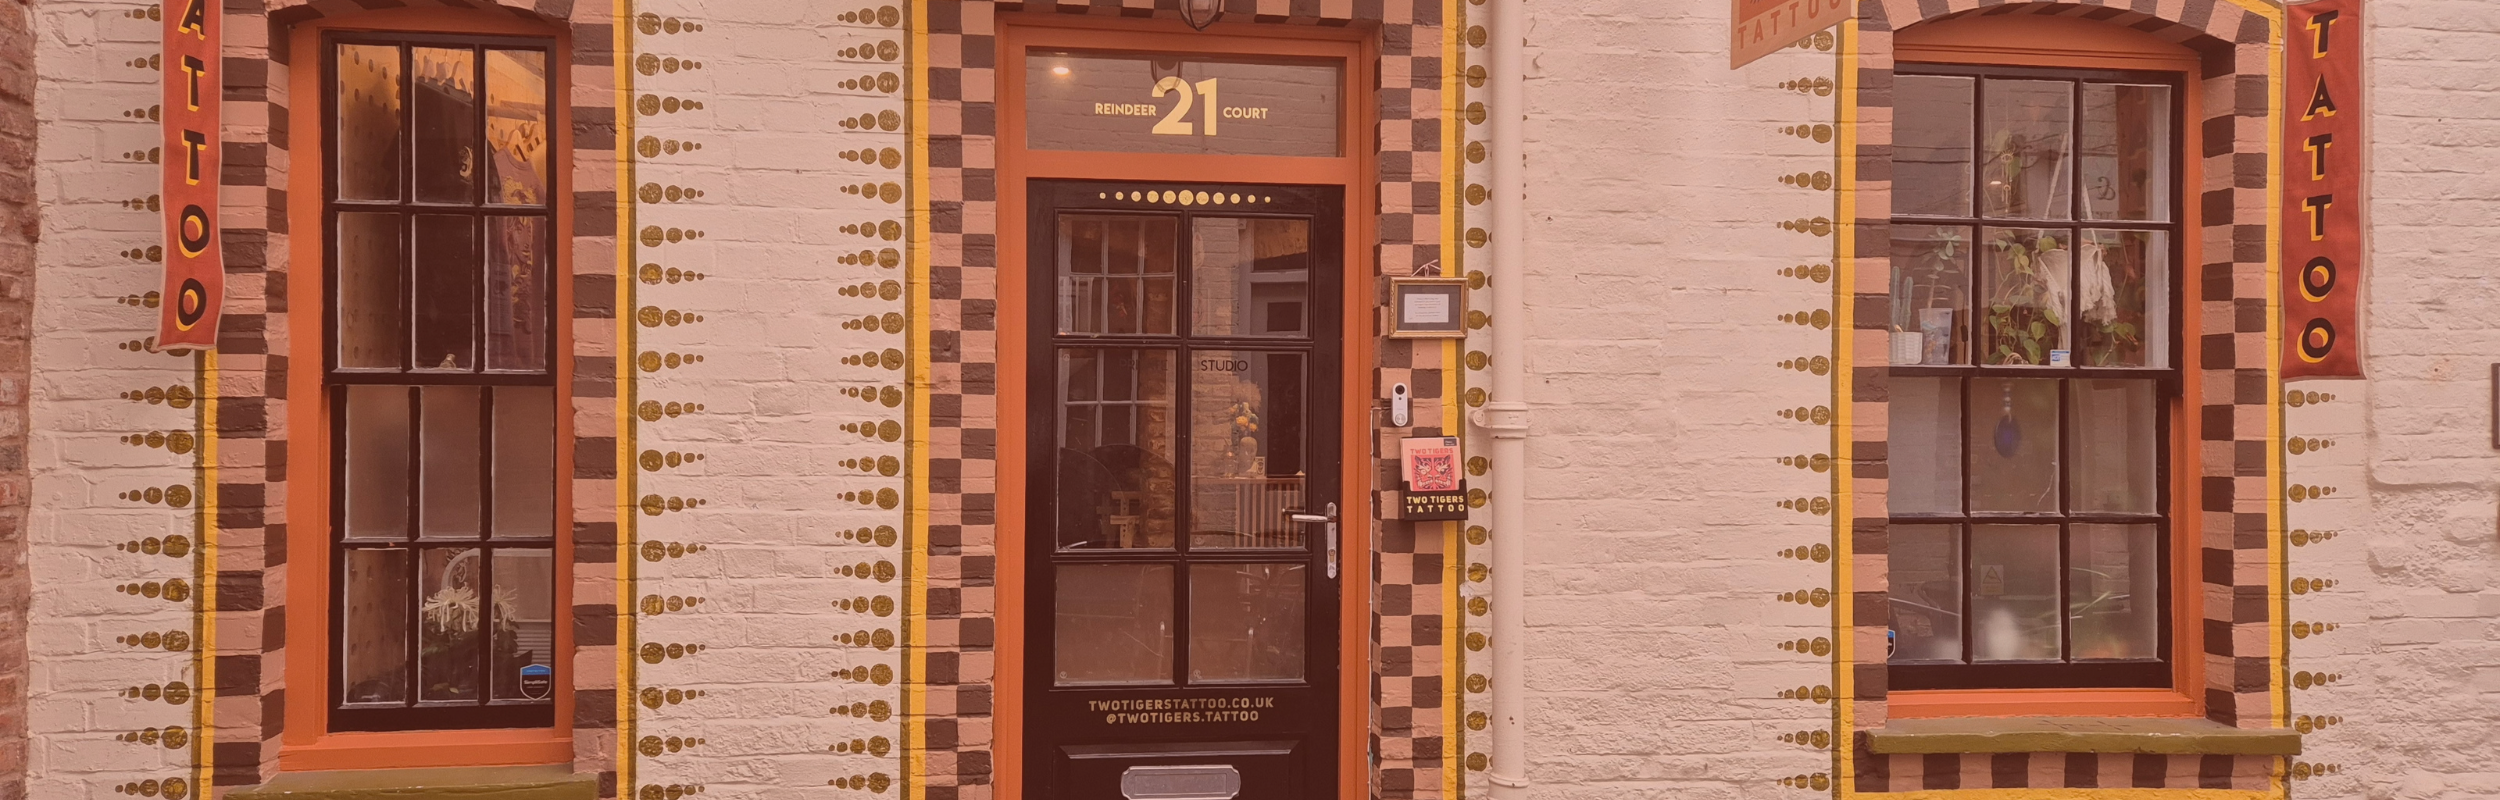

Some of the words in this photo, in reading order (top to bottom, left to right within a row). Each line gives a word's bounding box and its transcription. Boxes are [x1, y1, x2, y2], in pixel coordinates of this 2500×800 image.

[1095, 103, 1156, 116] REINDEER
[1151, 76, 1217, 136] 21
[1223, 107, 1268, 119] COURT
[2297, 9, 2339, 364] TATTOO
[1201, 359, 1248, 372] STUDIO
[1406, 496, 1428, 504] TWO
[1430, 495, 1464, 504] TIGERS
[1406, 504, 1465, 513] TATTOO
[1088, 697, 1275, 712] TWOTIGERSTATTOO.CO.UK
[1106, 710, 1259, 724] @TWOTIGERS.TATTOO
